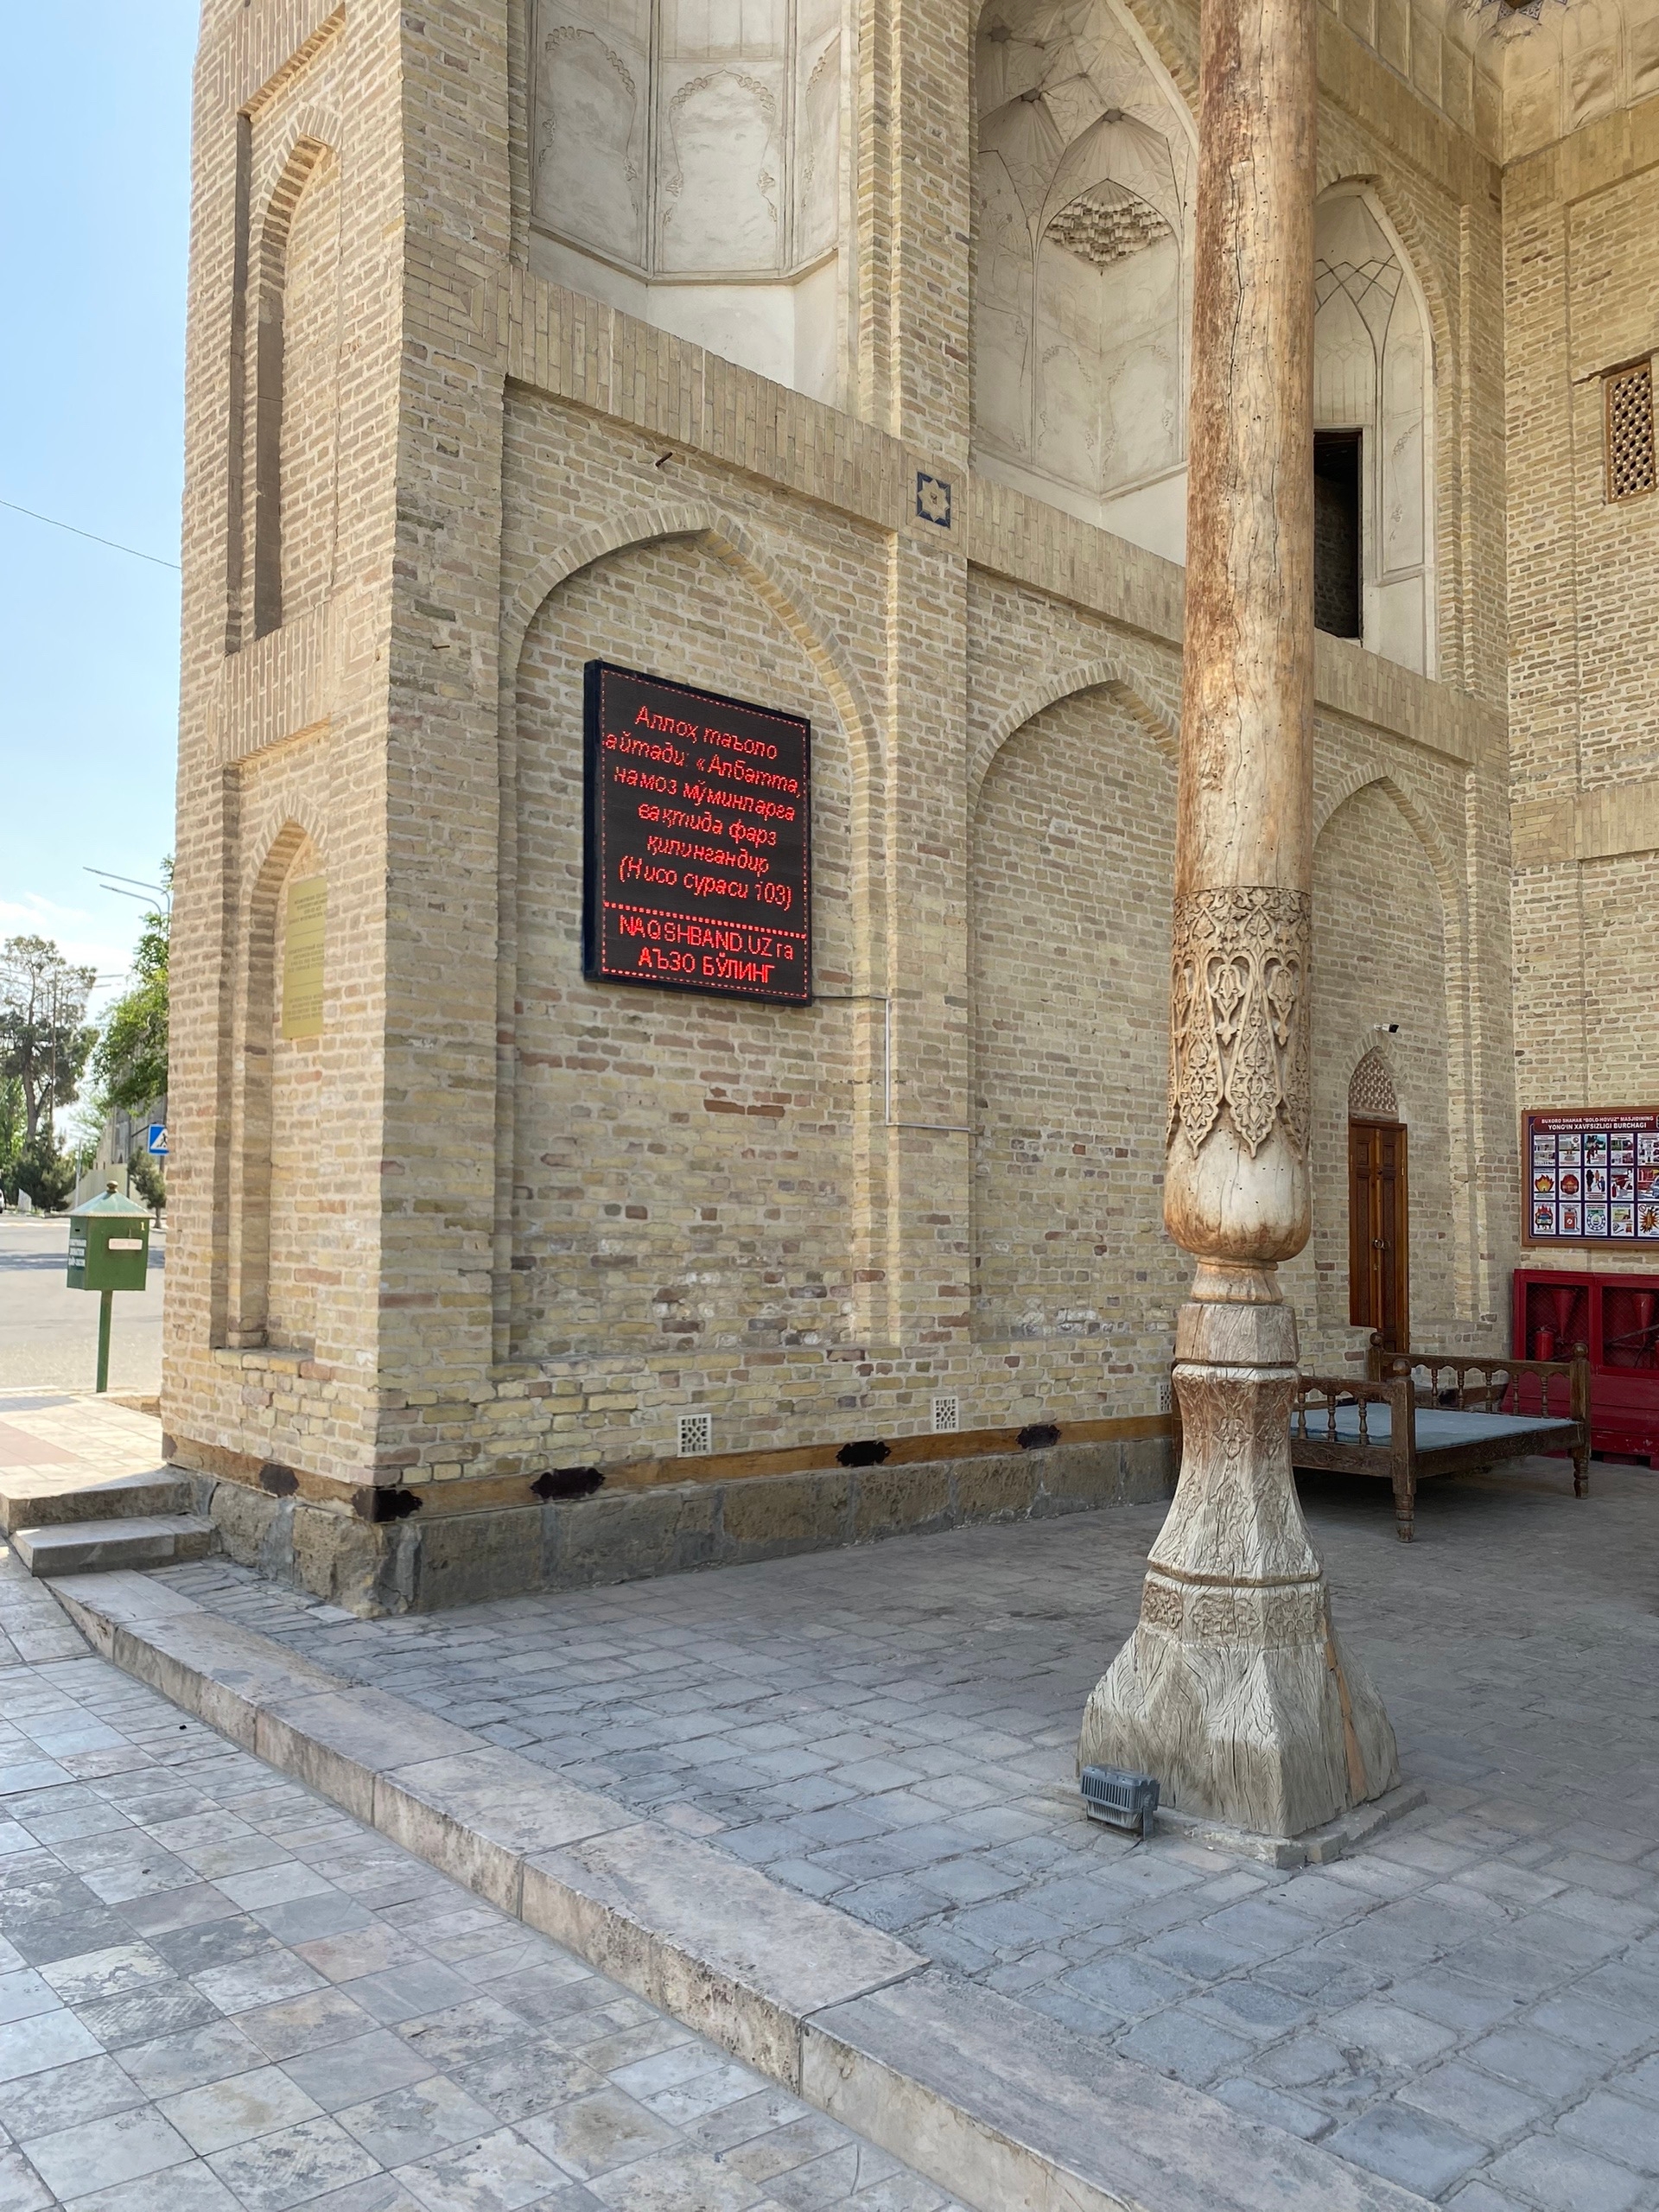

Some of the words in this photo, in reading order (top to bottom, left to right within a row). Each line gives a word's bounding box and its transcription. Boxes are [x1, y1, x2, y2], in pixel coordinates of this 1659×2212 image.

[702, 728, 778, 760] таъоло
[614, 766, 677, 795] намоз
[728, 819, 777, 848] фарз
[619, 855, 678, 886] (Нисо
[683, 872, 749, 899] сураси
[754, 880, 792, 912] 103)
[638, 947, 696, 973] АЪЗО
[702, 952, 775, 983] БЎЛИНГ
